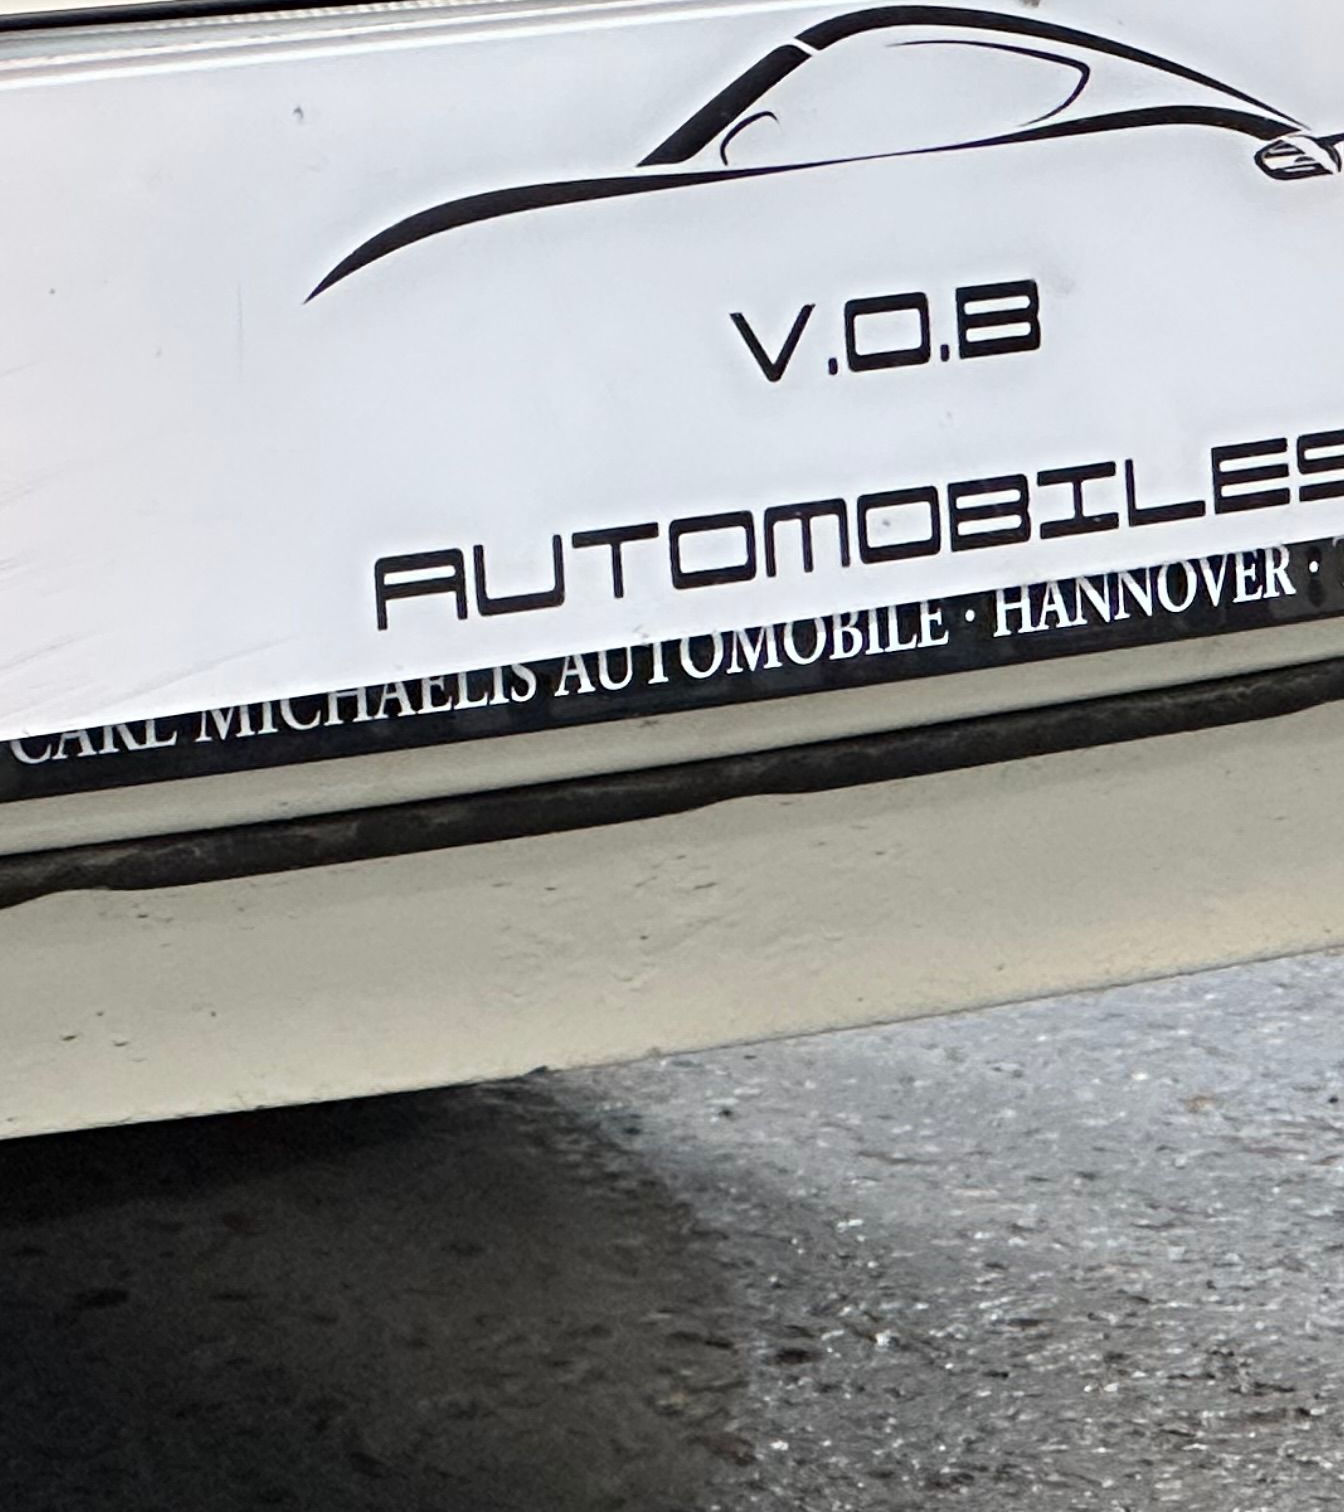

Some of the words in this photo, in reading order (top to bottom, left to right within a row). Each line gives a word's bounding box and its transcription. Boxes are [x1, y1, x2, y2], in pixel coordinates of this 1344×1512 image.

[729, 278, 1042, 383] V.O.B
[554, 600, 949, 697] AUTOMOBILE
[993, 543, 1297, 638] HANNOVER
